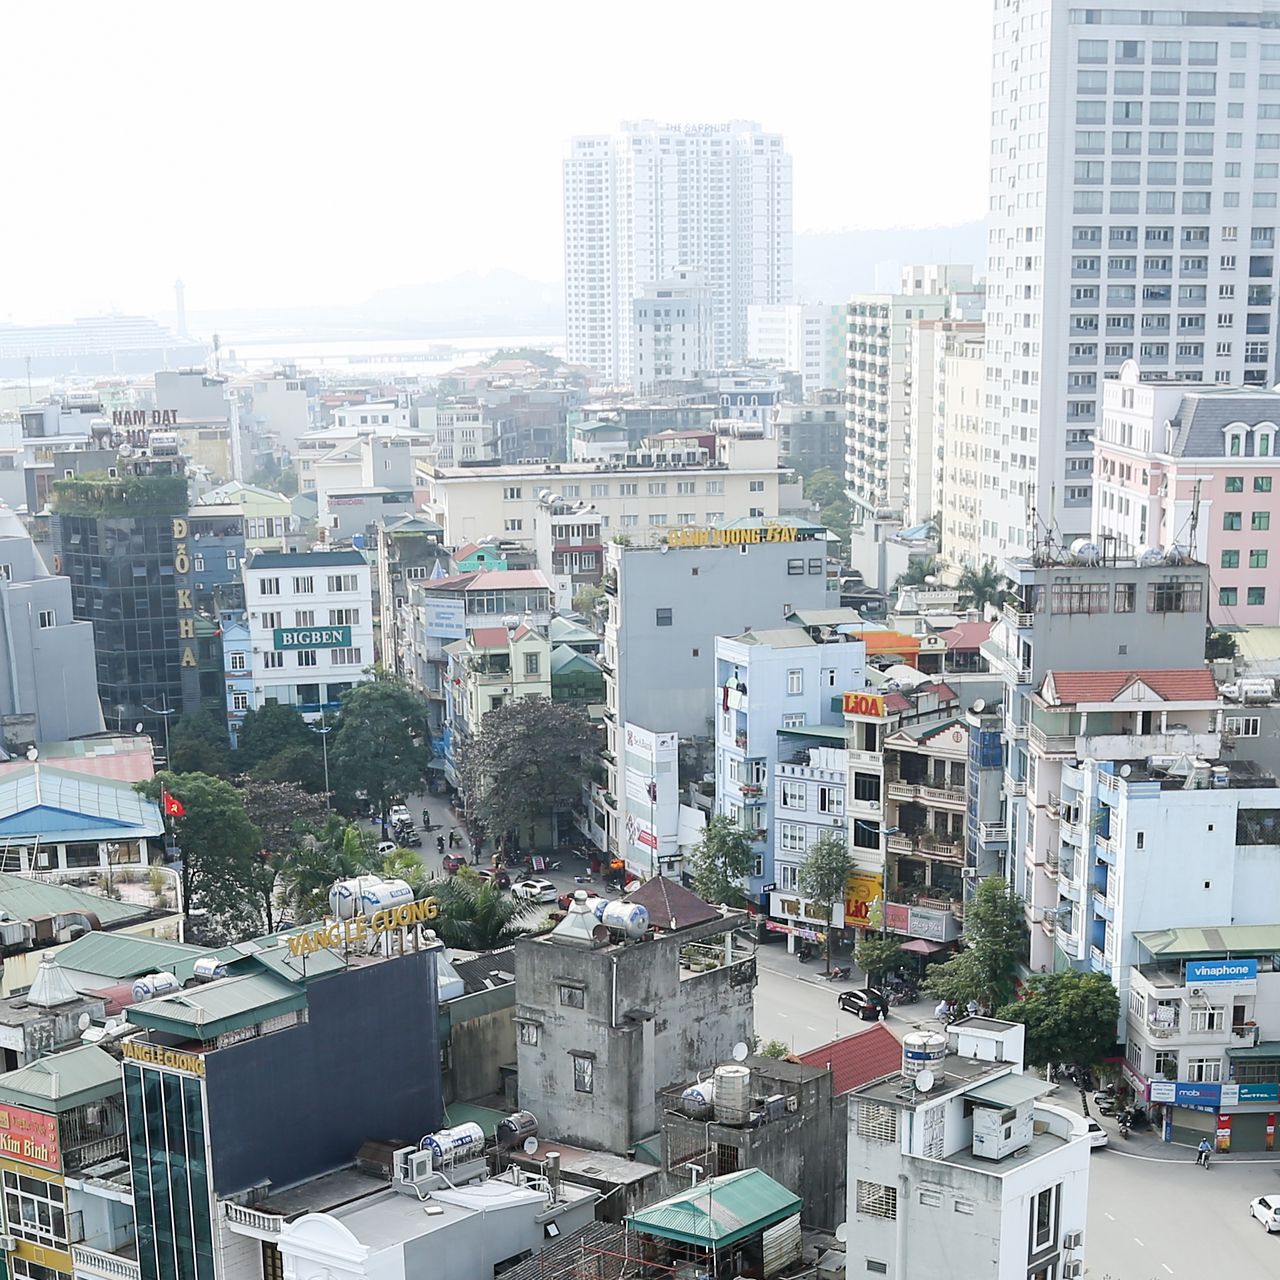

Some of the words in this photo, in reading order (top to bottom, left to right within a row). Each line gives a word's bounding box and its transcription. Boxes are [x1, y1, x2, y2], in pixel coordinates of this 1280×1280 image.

[113, 410, 145, 425] NAM
[282, 629, 344, 646] BIGBEN
[844, 695, 880, 716] LiOA
[1195, 964, 1249, 976] vinaphone
[0, 1132, 20, 1154] Kim
